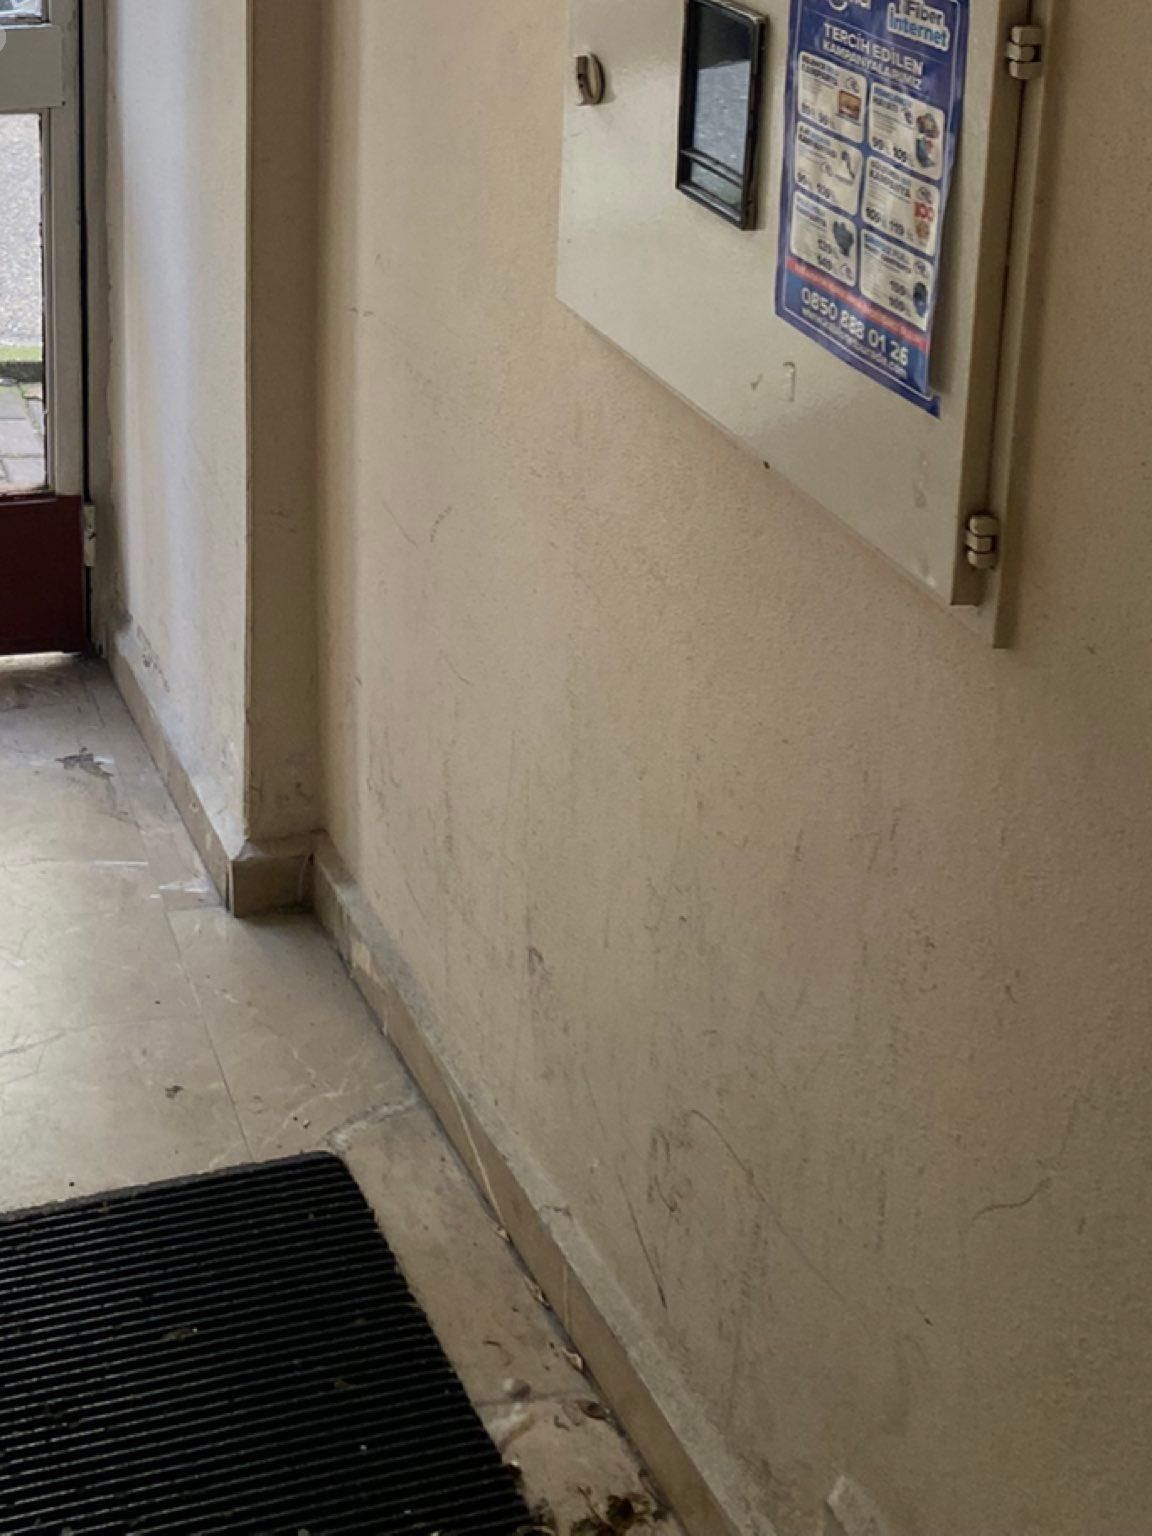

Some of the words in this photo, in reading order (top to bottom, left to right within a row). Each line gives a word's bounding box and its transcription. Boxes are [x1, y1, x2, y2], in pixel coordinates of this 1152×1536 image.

[824, 22, 870, 54] TERCİH
[872, 41, 924, 75] EDİLEN
[801, 287, 838, 321] 0850
[868, 329, 887, 353] 01
